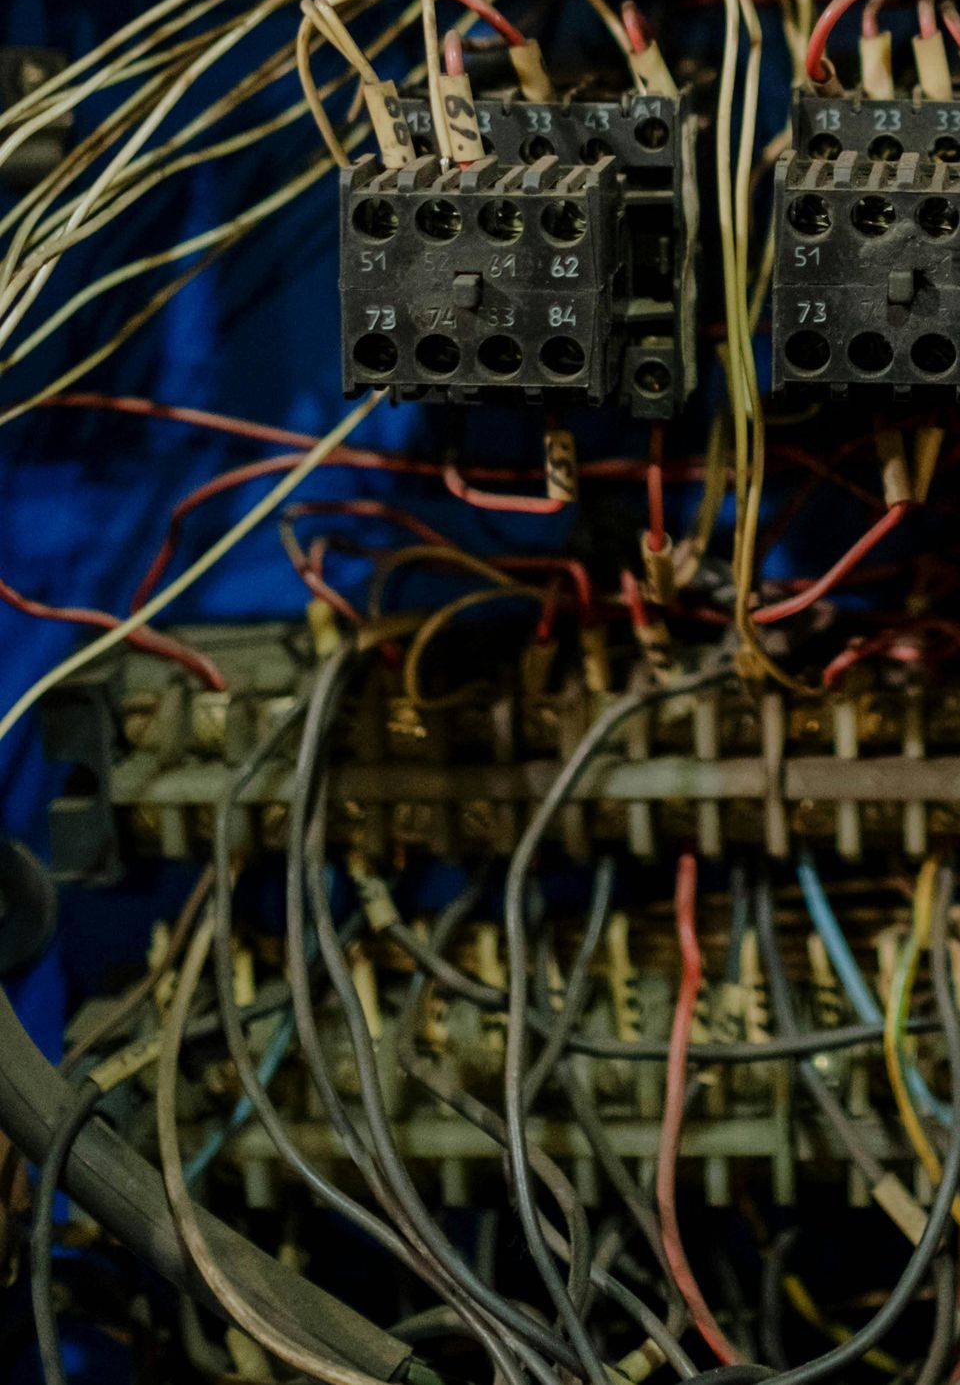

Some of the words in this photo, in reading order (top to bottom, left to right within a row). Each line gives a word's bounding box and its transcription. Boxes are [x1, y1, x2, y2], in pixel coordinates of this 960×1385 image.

[408, 111, 432, 134] 13
[526, 111, 552, 133] 33
[584, 110, 610, 132] 43
[634, 98, 662, 119] A1
[816, 108, 841, 131] 13
[873, 108, 902, 131] 23
[361, 251, 387, 272] 51
[425, 251, 450, 272] 52
[489, 253, 517, 277] 61
[551, 255, 580, 279] 62
[794, 248, 821, 267] 51
[366, 307, 398, 331] 73
[548, 306, 577, 327] 84
[797, 303, 828, 323] 73
